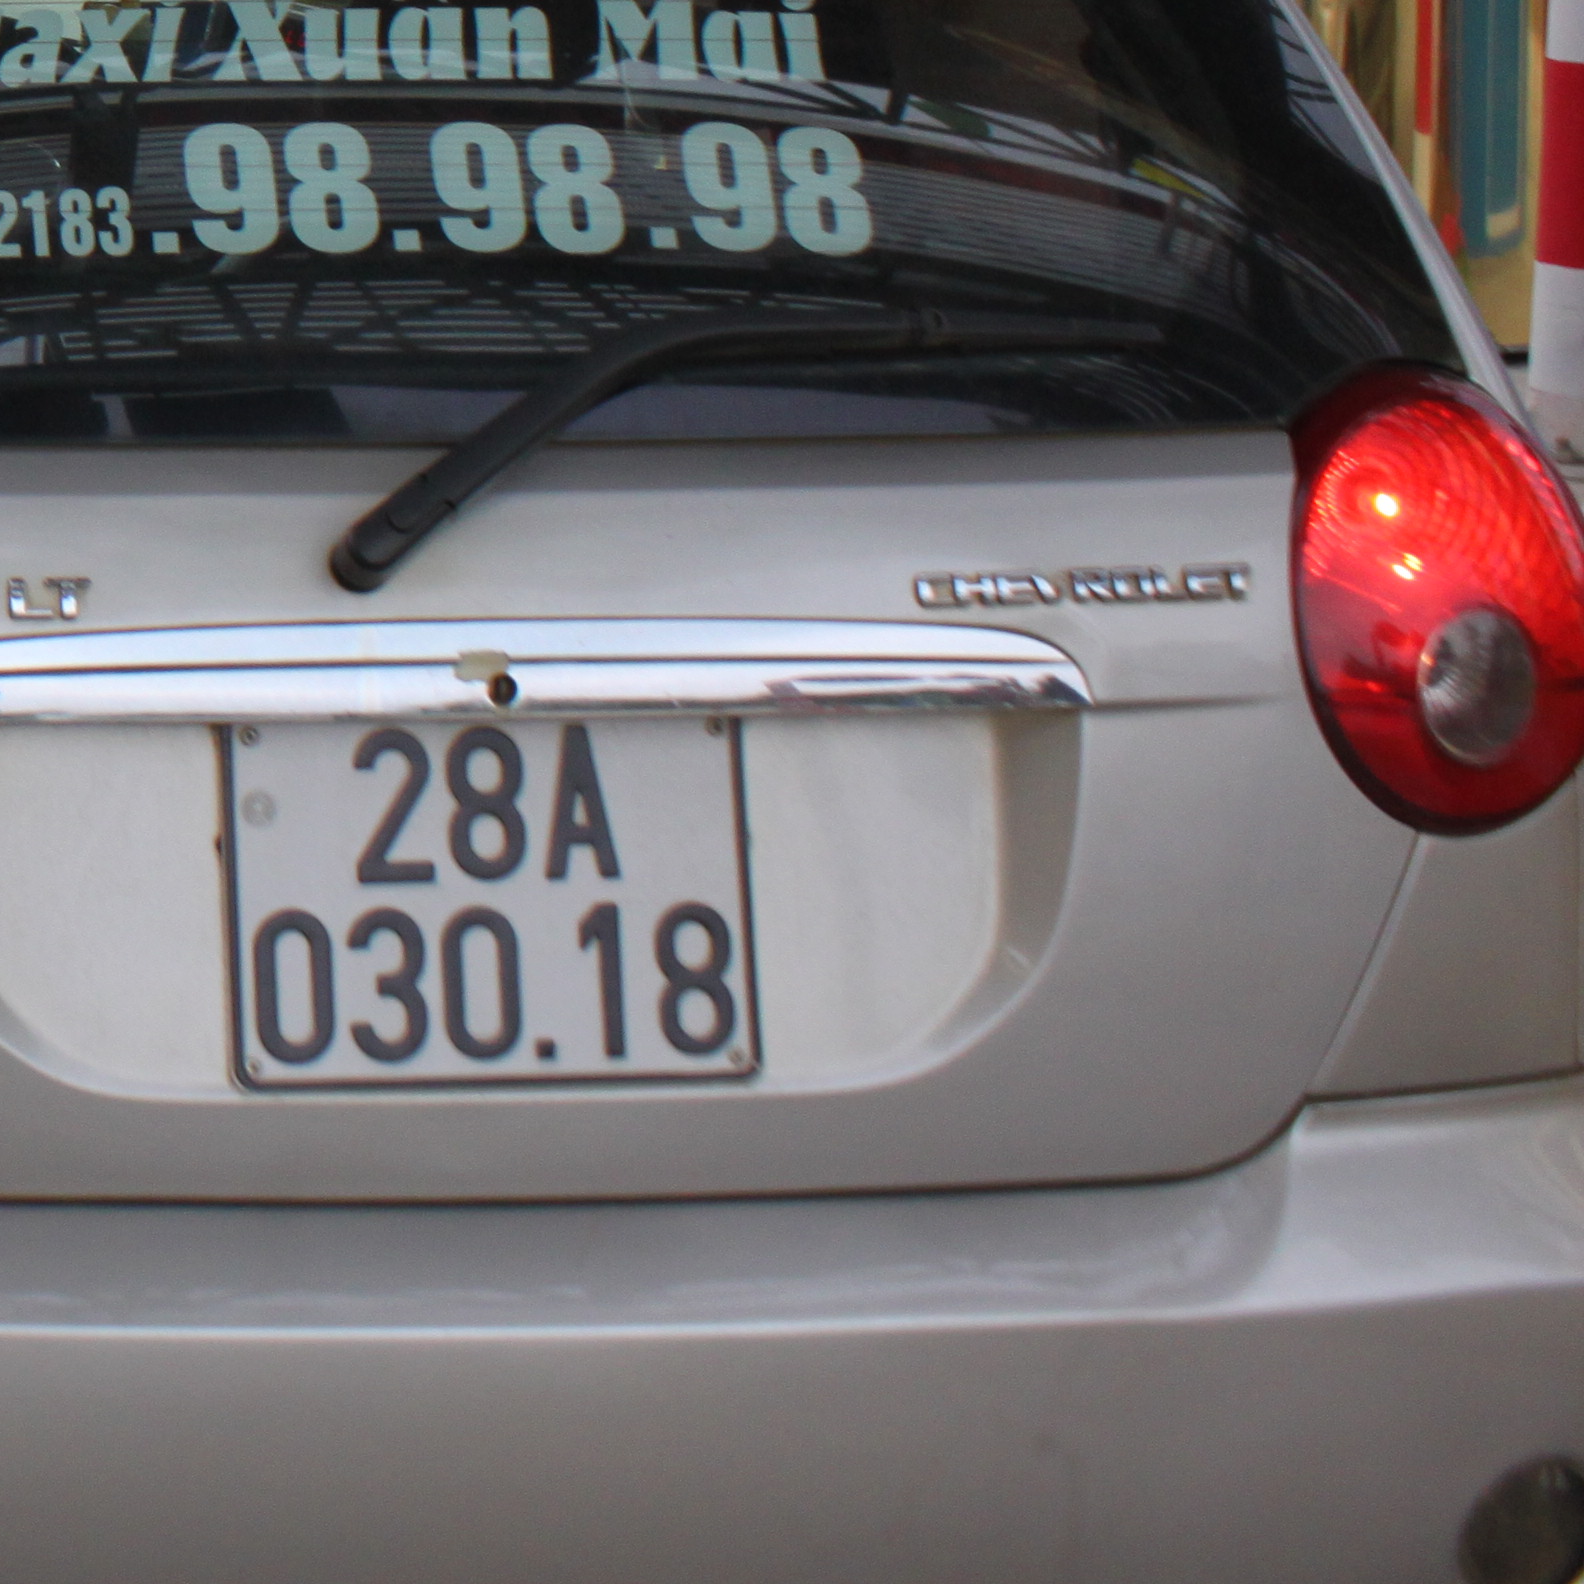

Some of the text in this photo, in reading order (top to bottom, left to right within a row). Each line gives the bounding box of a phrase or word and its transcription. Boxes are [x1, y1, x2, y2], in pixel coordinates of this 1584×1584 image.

[7, 576, 92, 620] LT
[912, 561, 1252, 610] CHEVROLET
[351, 723, 623, 885] 28A
[252, 899, 738, 1065] 030.18
